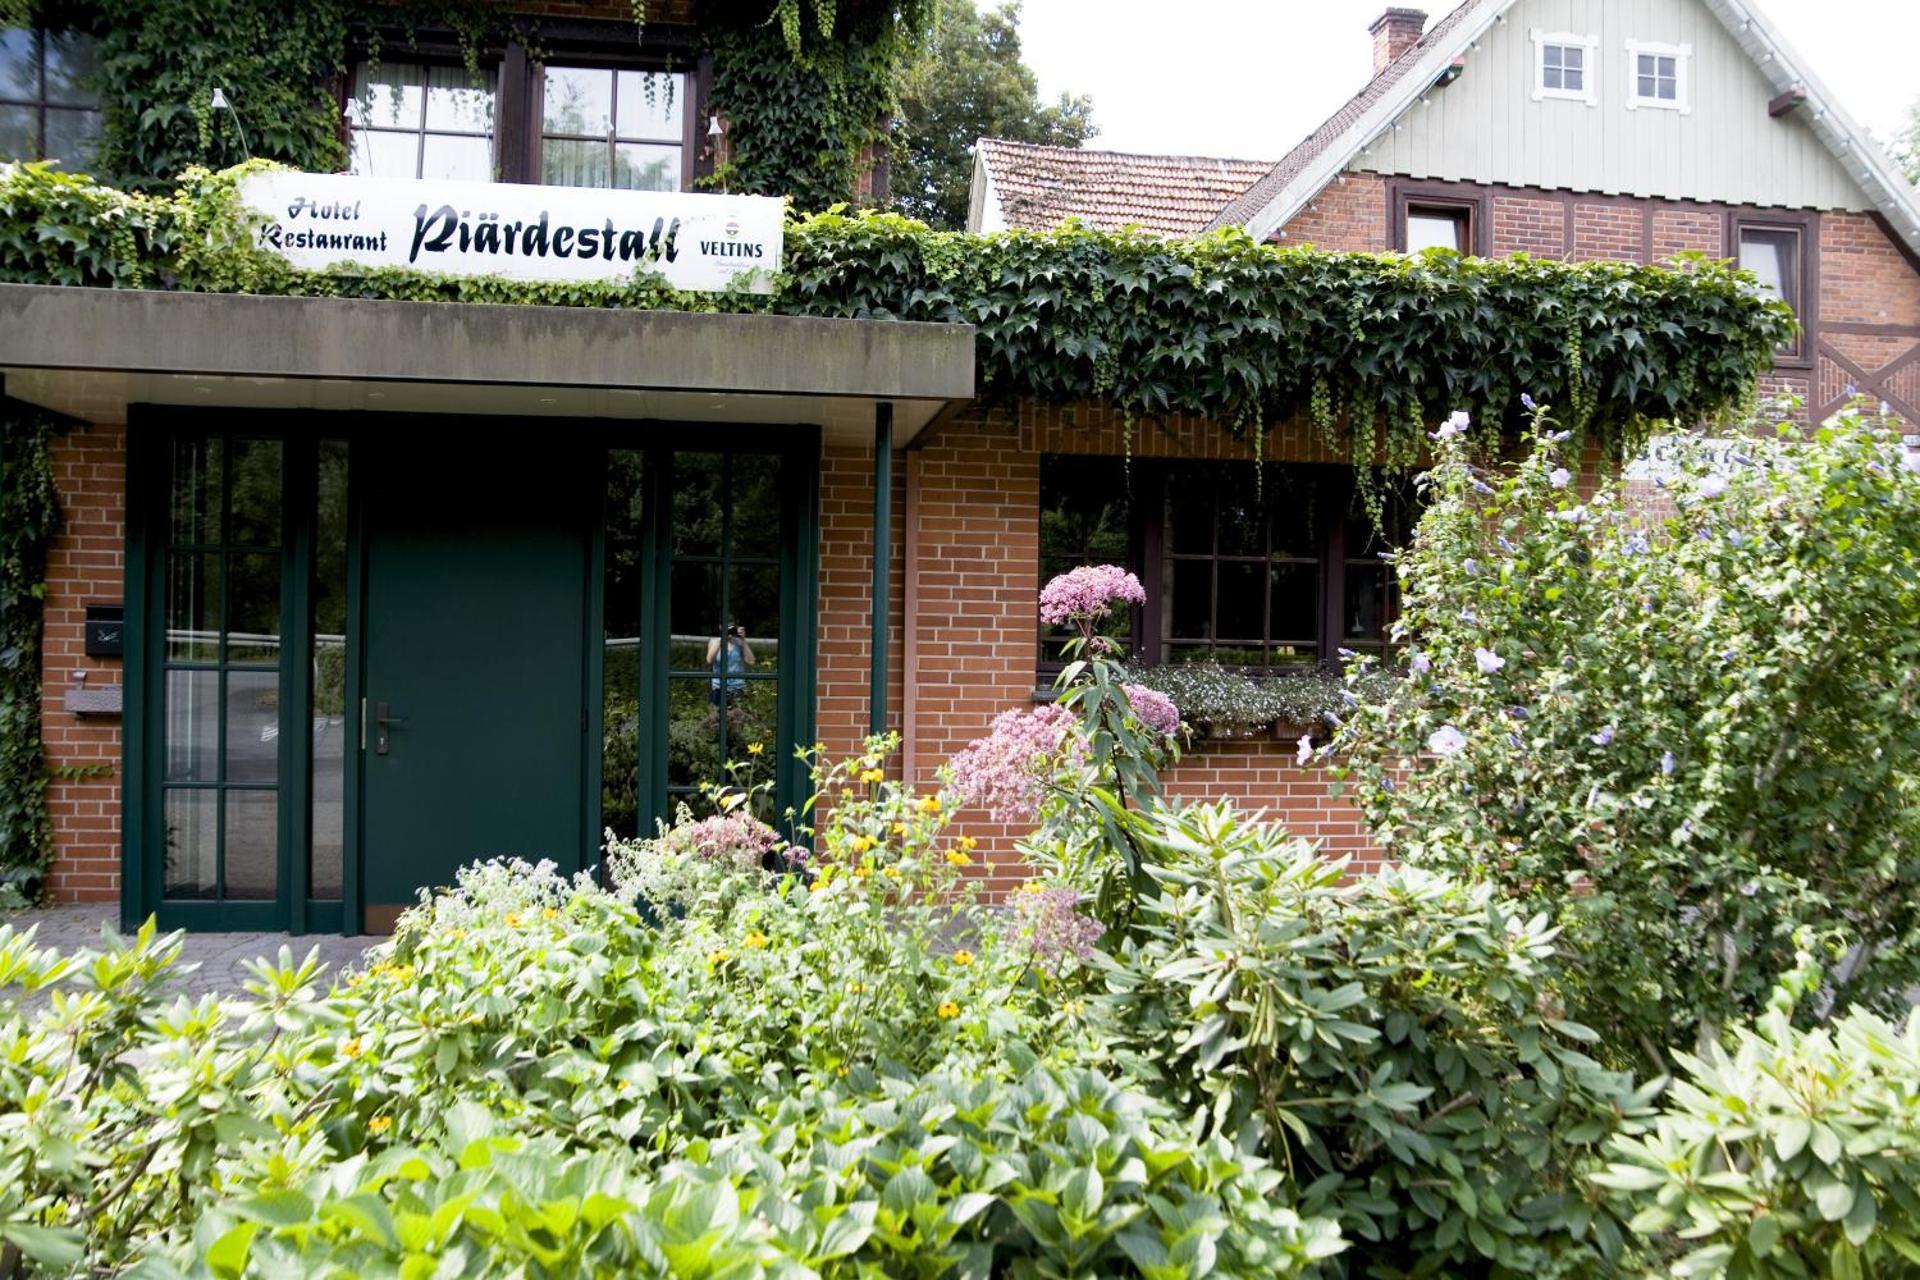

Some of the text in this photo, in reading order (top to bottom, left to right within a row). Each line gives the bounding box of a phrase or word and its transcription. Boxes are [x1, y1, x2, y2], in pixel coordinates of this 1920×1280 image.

[287, 197, 361, 221] Hotel
[258, 223, 387, 251] Restaurant
[409, 203, 680, 264] Piärdestall
[700, 240, 763, 258] VELTINS
